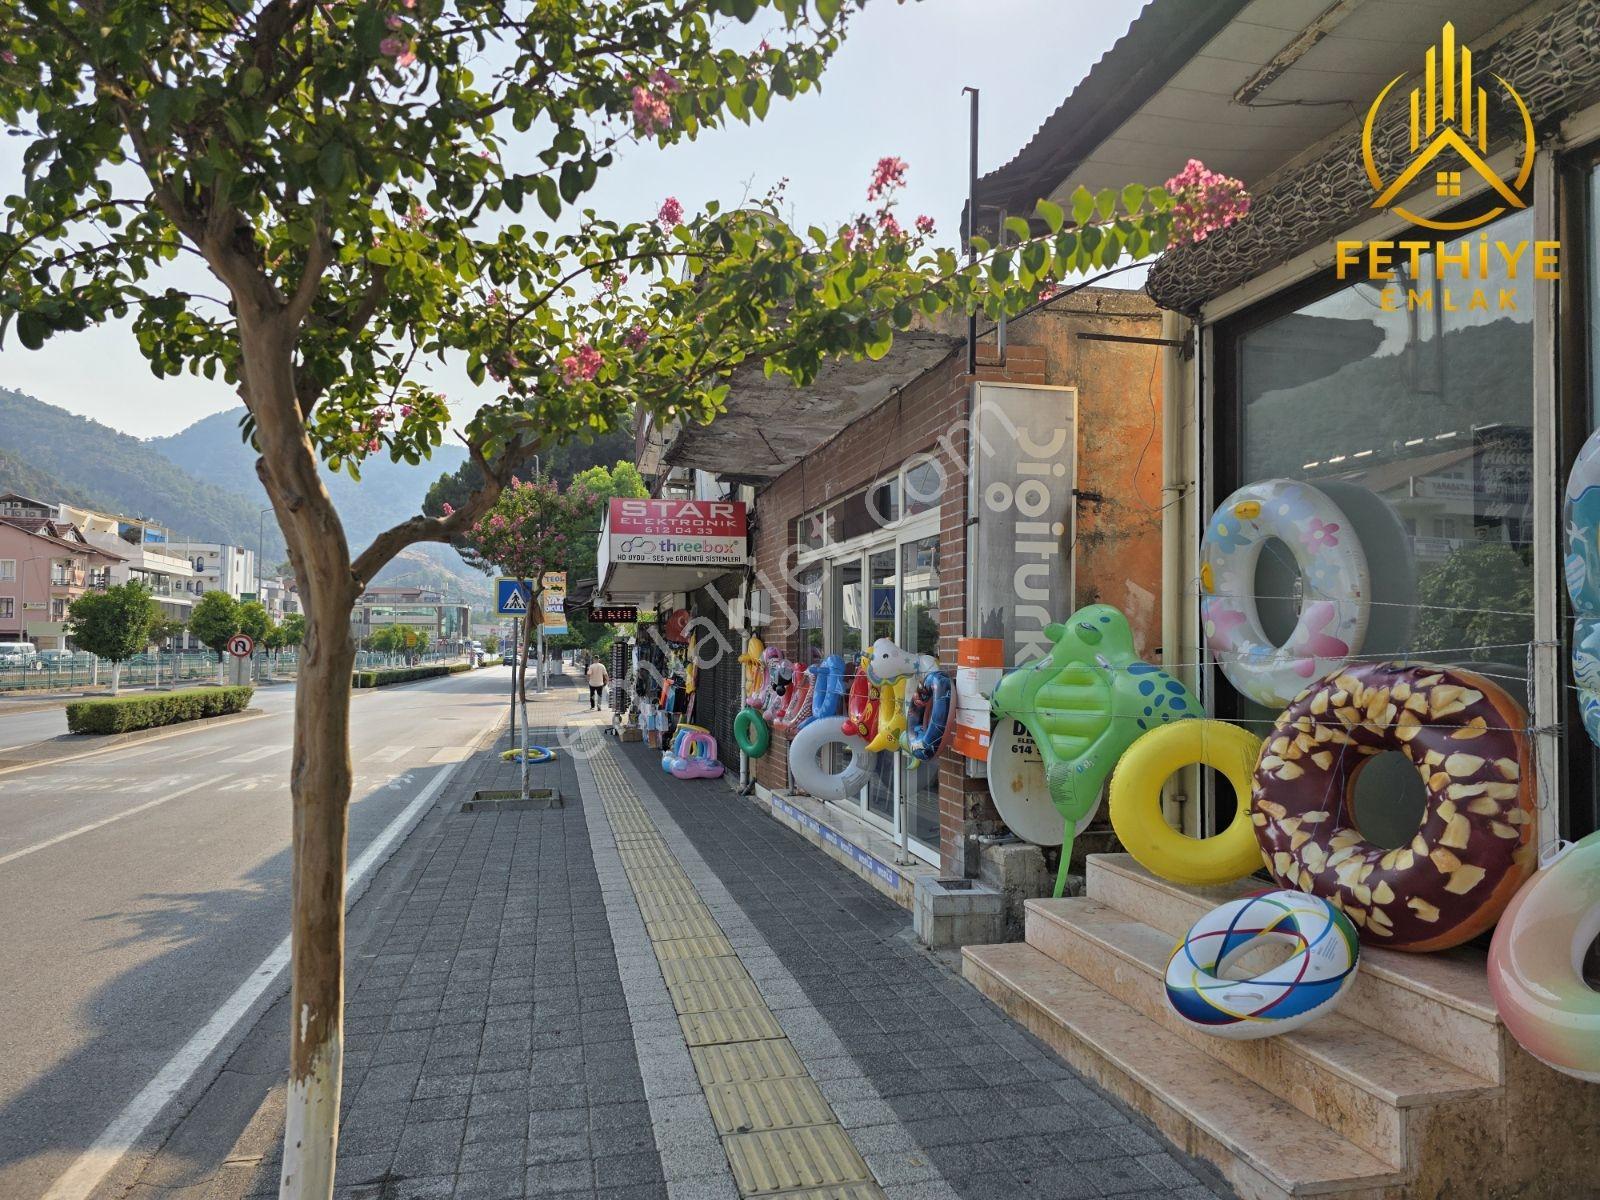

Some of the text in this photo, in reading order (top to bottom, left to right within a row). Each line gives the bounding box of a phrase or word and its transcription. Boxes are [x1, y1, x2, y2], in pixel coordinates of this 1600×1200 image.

[623, 502, 734, 518] STAR
[620, 517, 738, 528] ELEKTRONIK
[659, 539, 734, 554] threebox
[1011, 745, 1032, 754] 614
